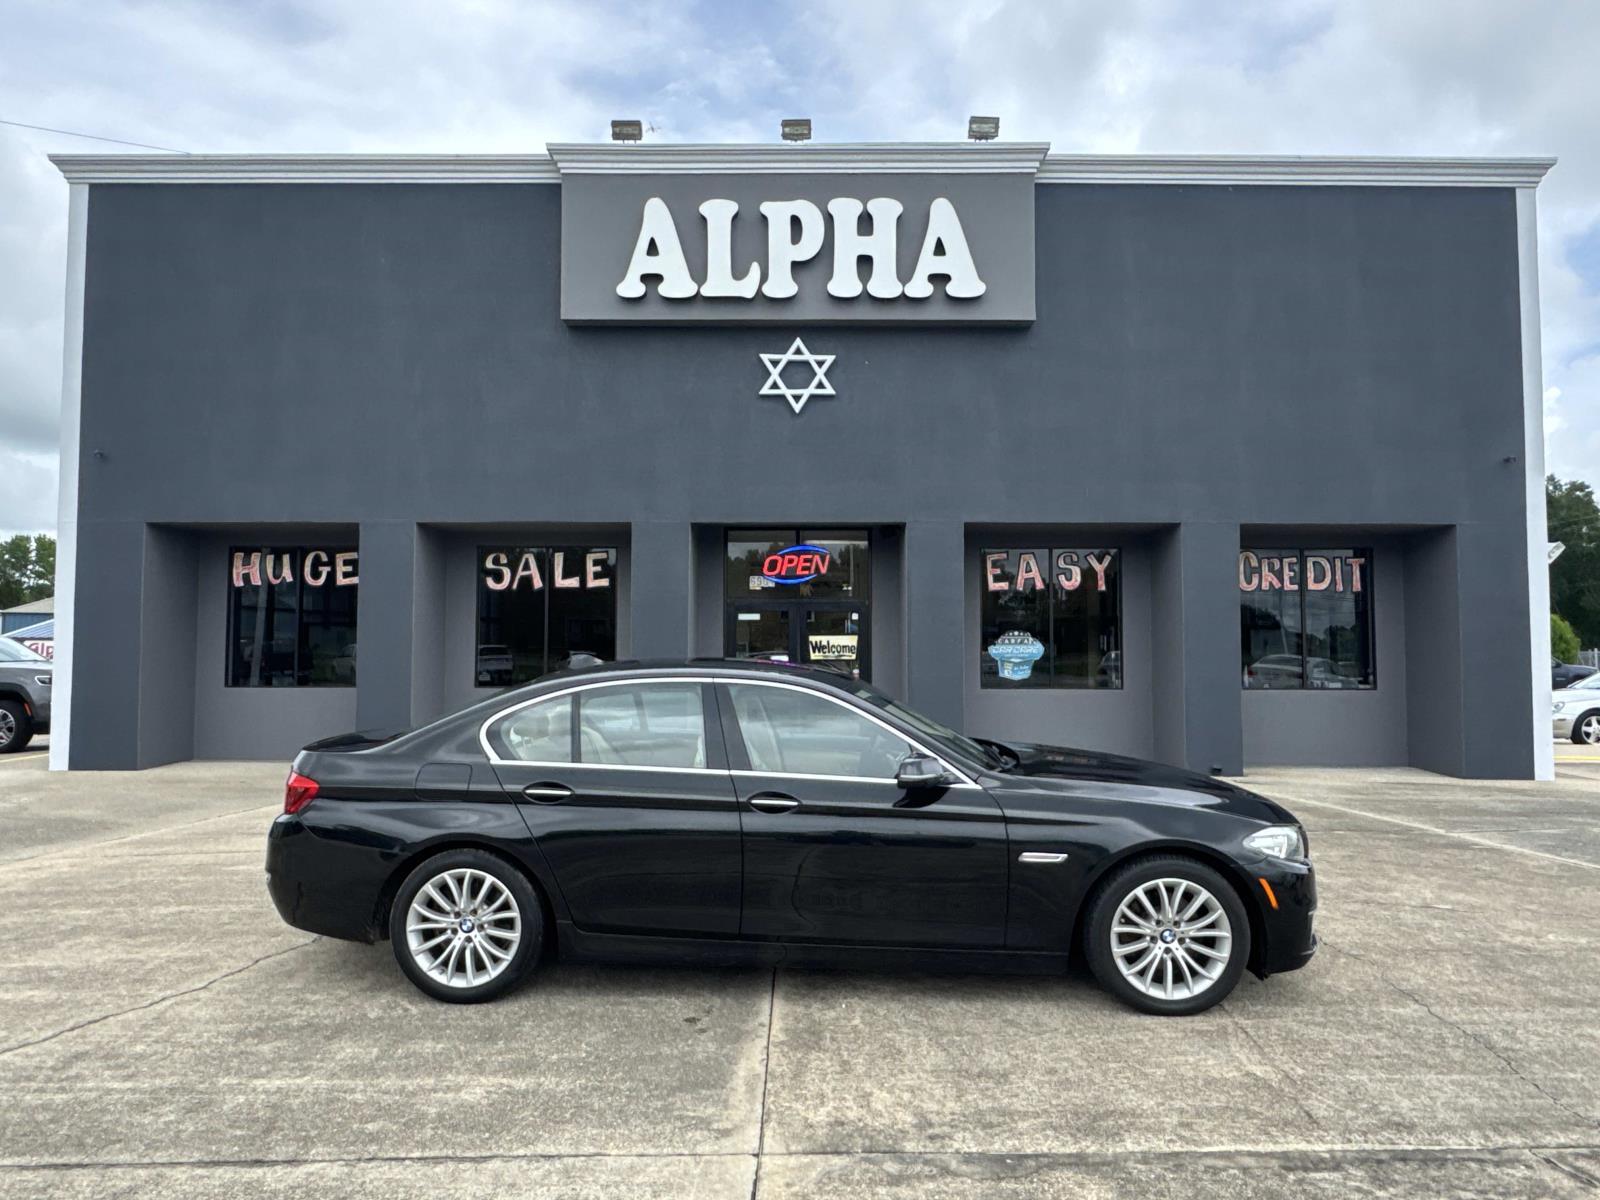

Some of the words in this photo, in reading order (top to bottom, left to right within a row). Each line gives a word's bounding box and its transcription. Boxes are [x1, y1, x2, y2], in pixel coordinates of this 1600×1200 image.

[616, 197, 986, 299] ALPHA
[232, 551, 359, 587] HUGE
[485, 552, 610, 590] SALE
[763, 554, 830, 576] OPEN
[986, 552, 1112, 591] EASY
[1239, 551, 1365, 592] CREDIT
[809, 640, 856, 654] Welcome
